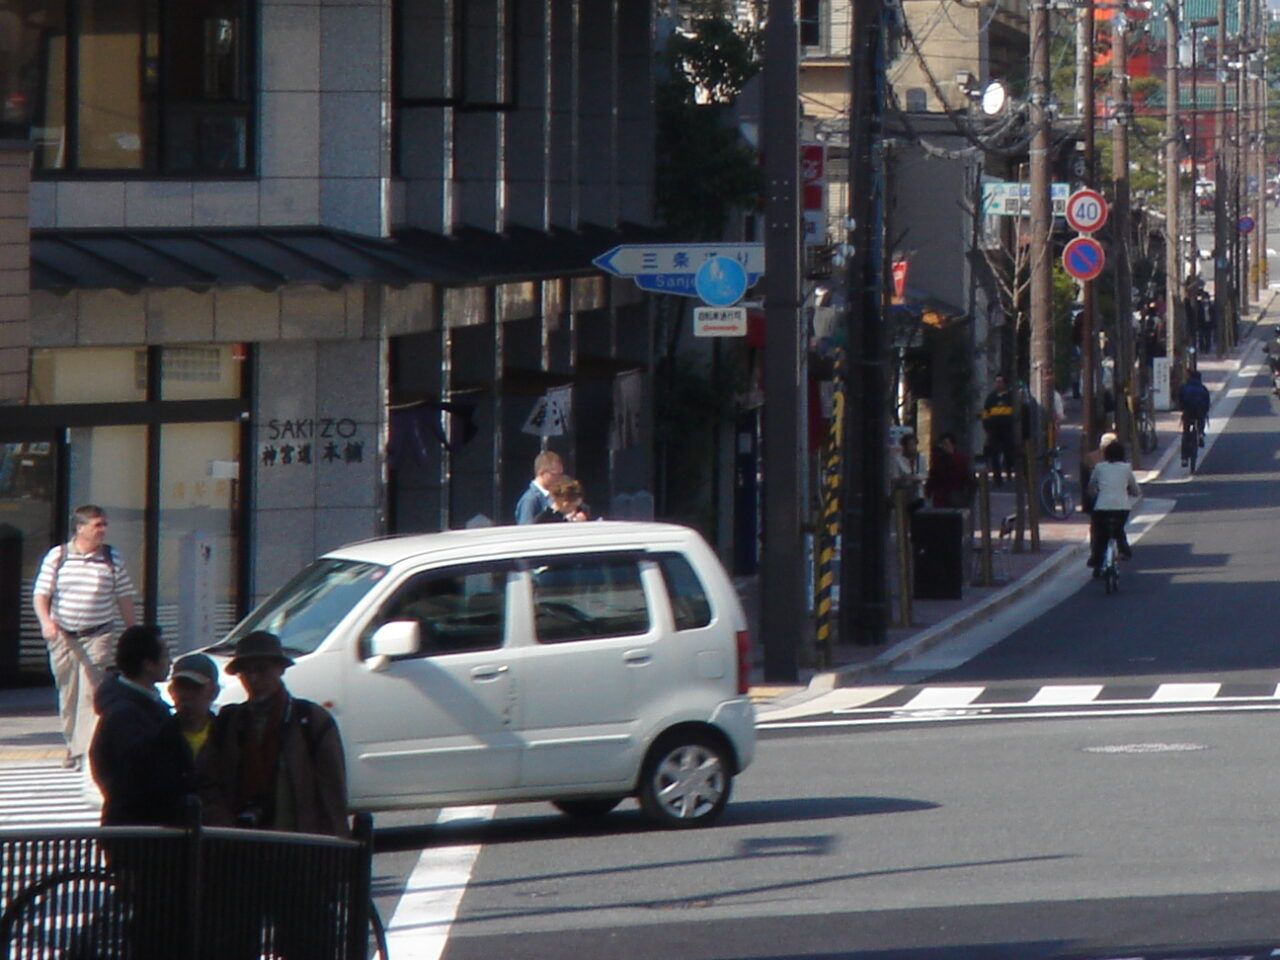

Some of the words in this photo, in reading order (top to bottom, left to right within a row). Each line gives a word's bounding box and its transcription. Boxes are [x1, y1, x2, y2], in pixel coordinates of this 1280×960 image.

[1076, 201, 1098, 220] 40
[642, 251, 748, 269] 三条り
